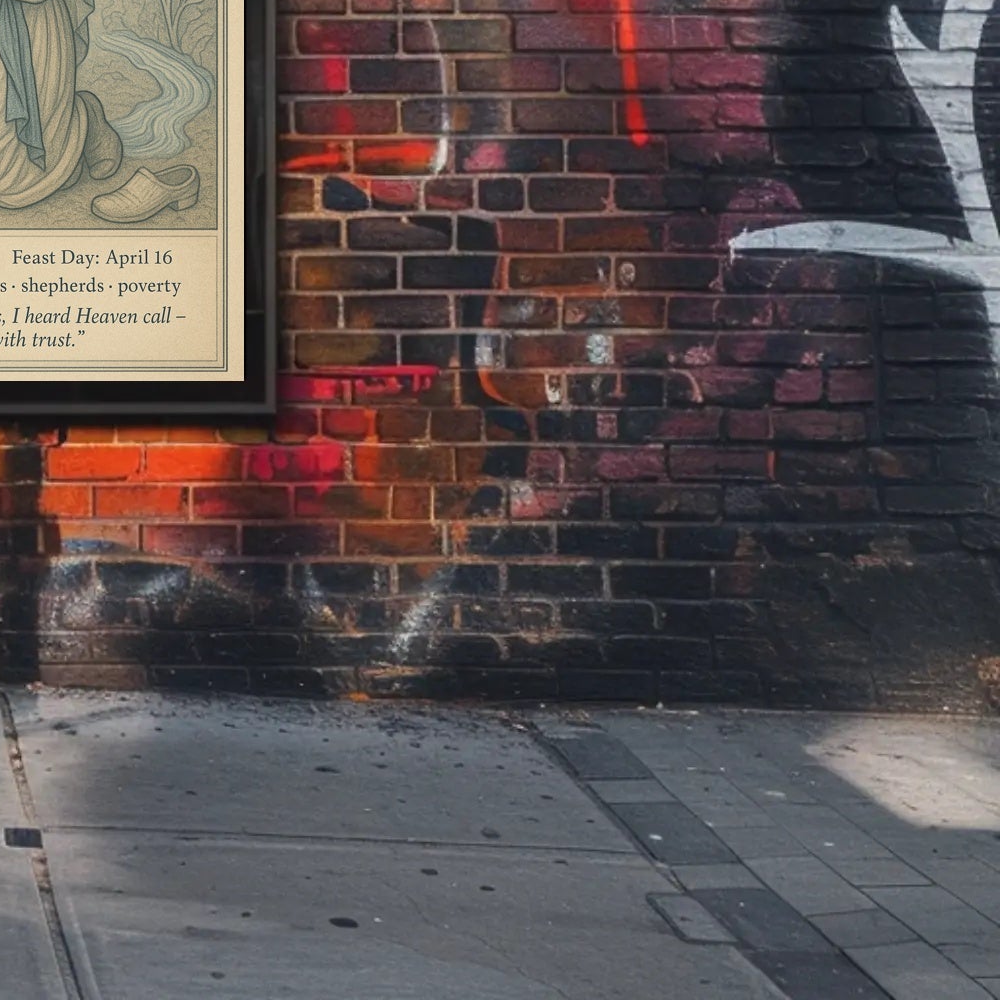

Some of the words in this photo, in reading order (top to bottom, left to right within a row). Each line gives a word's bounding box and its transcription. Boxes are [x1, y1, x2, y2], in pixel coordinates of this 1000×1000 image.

[12, 249, 56, 265] Feast
[61, 249, 100, 269] Day:
[105, 248, 149, 269] April
[154, 249, 173, 265] 16
[21, 276, 105, 297] shepherds
[117, 279, 182, 298] poverty
[12, 307, 21, 324] I
[24, 305, 71, 324] heard
[75, 307, 138, 324] Heaven
[143, 305, 172, 324] call
[32, 329, 86, 348] trust.”
